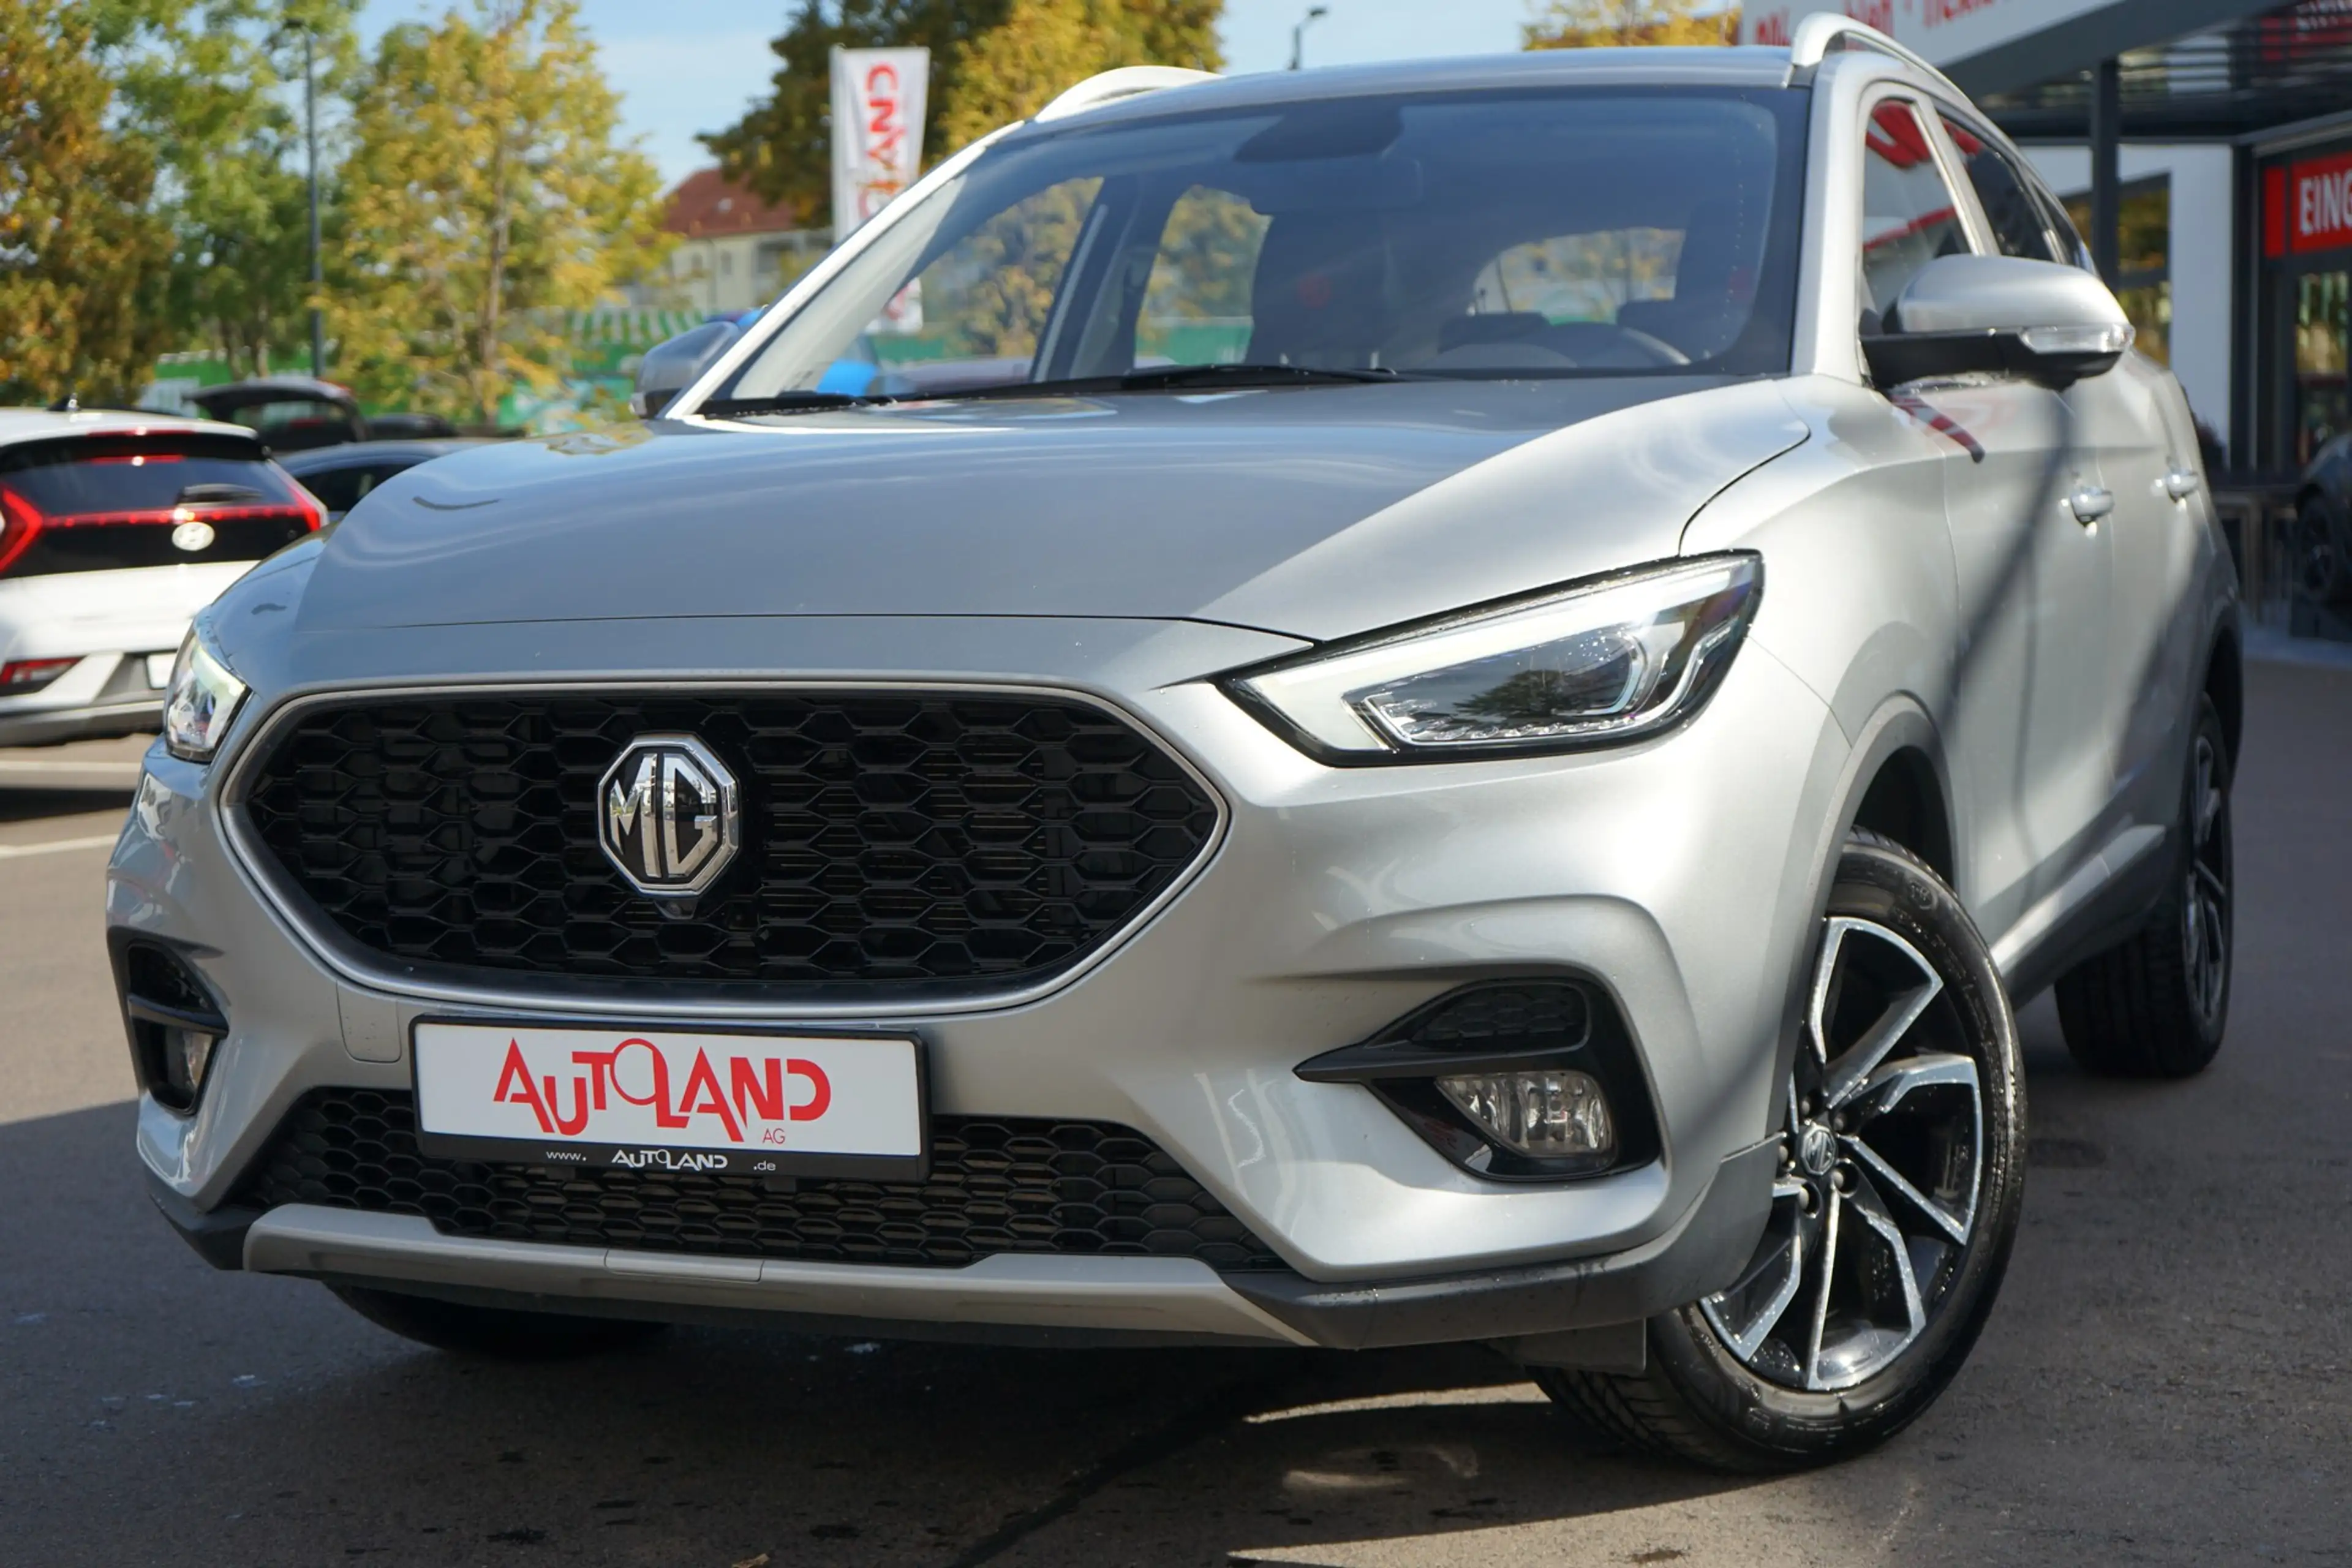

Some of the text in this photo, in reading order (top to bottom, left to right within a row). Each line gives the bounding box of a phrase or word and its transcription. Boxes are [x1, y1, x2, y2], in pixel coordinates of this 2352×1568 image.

[610, 753, 717, 878] MG
[493, 1038, 831, 1142] AUTOLAND
[546, 1149, 777, 1171] www. AUTOLAND .de
[762, 1128, 786, 1144] AG
